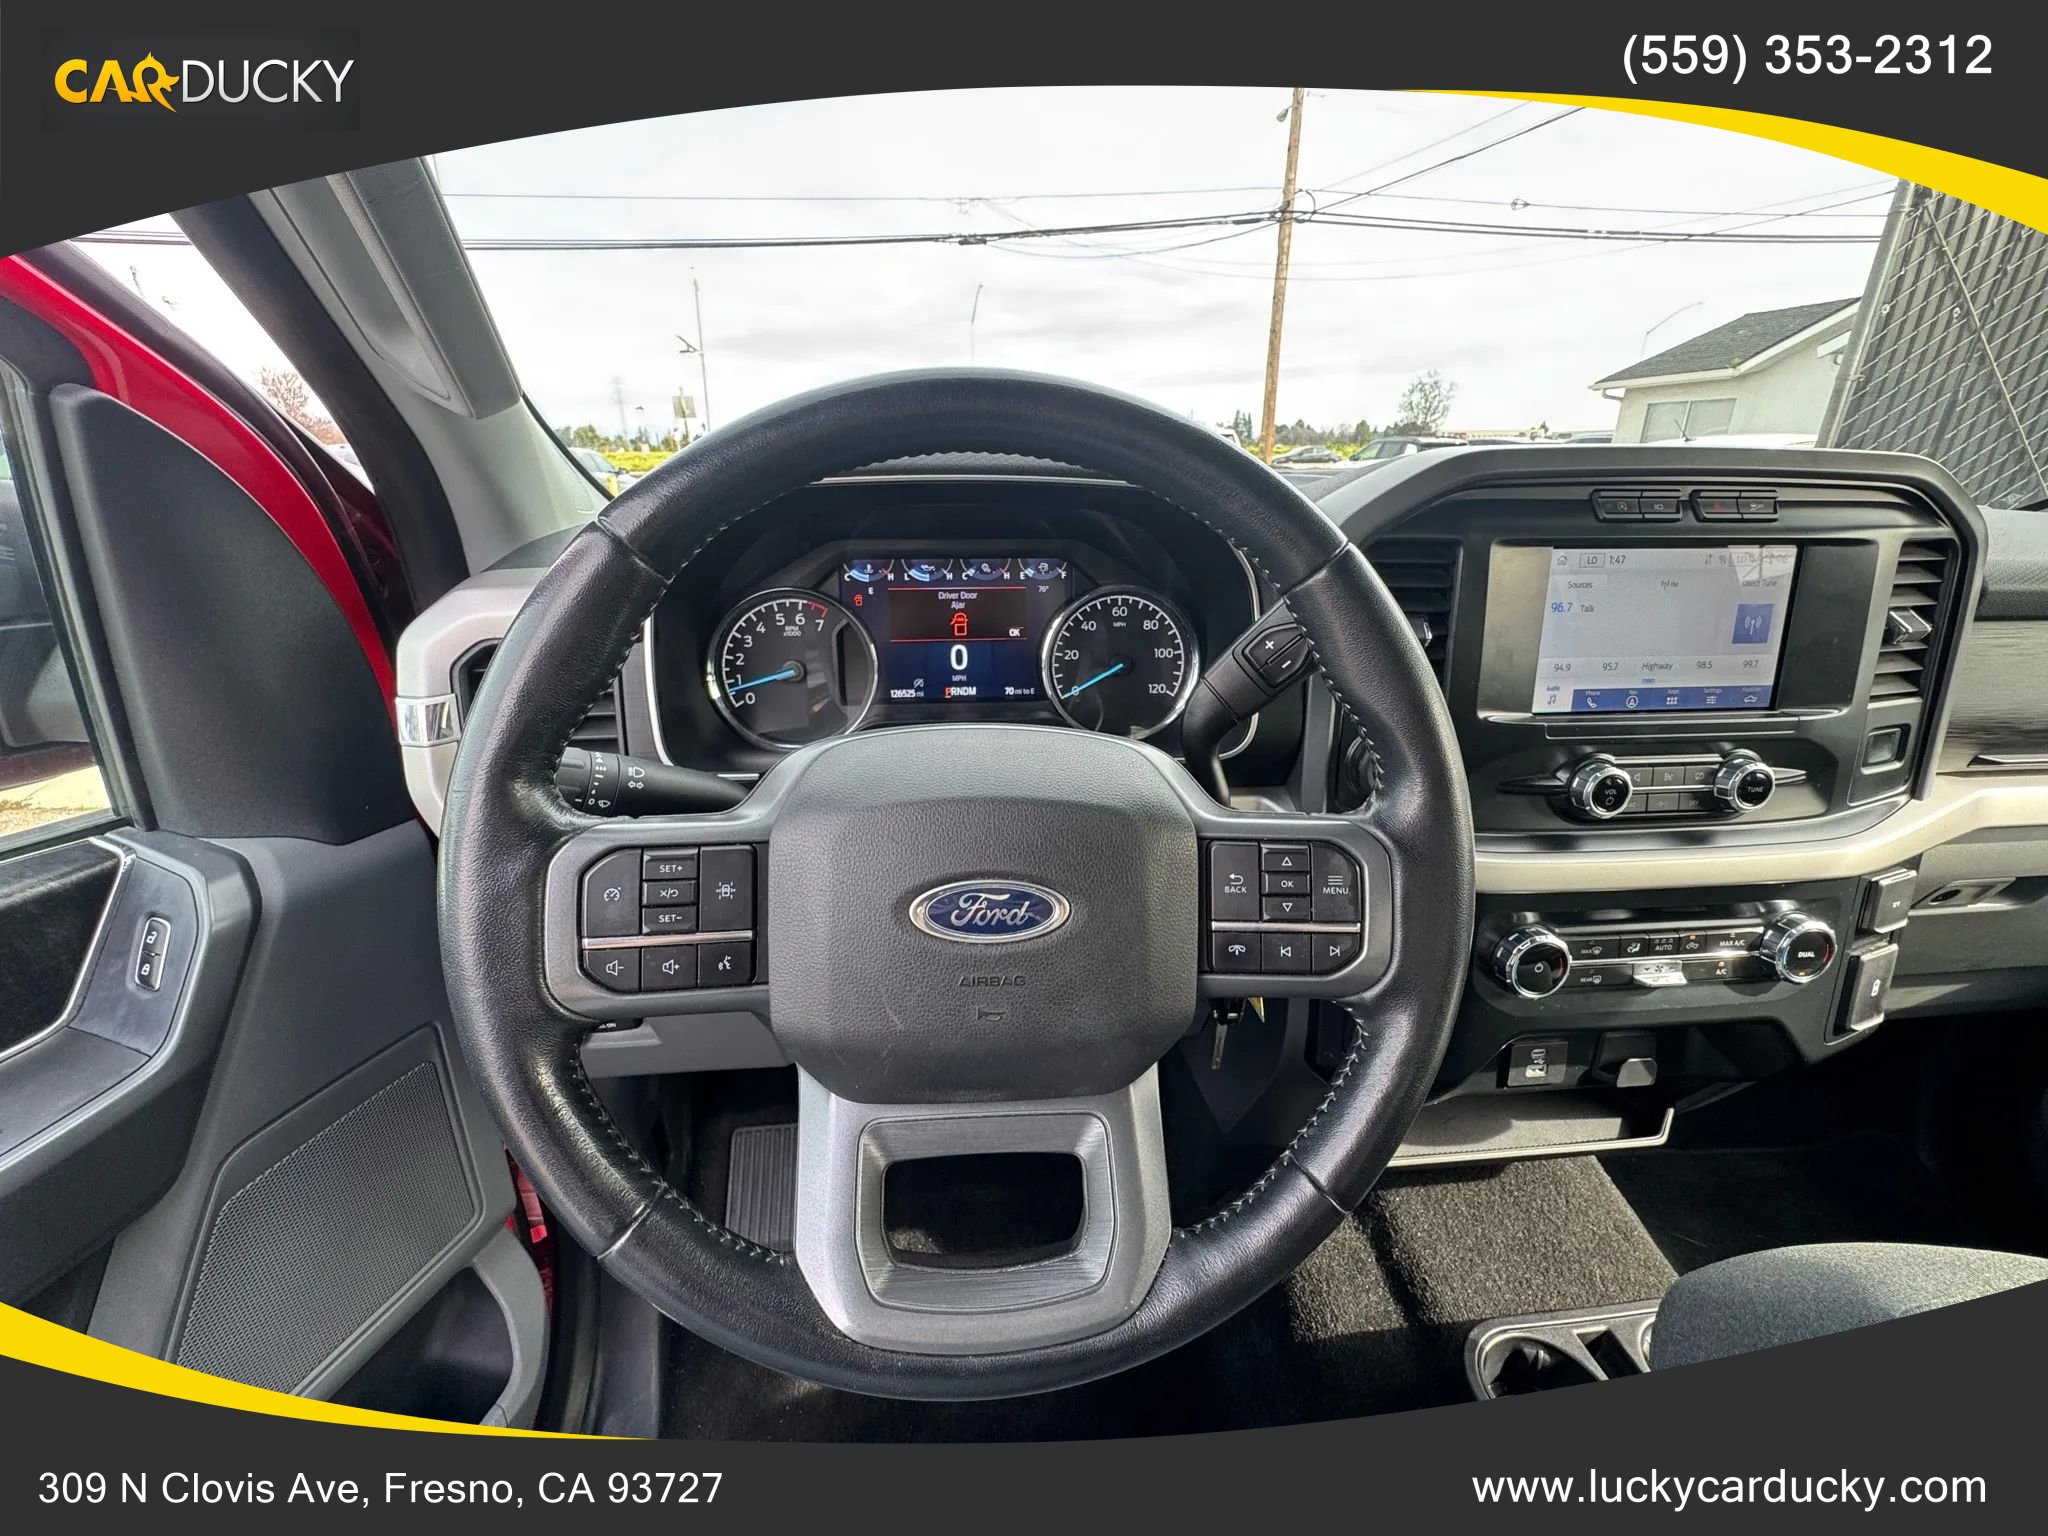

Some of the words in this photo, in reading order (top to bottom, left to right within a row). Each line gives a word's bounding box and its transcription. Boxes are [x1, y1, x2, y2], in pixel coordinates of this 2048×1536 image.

[1608, 555, 1626, 565] 1:47
[844, 573, 850, 581] C
[888, 573, 894, 581] H
[904, 573, 910, 581] L
[962, 572, 968, 580] C
[1004, 572, 1010, 580] H
[1020, 572, 1026, 580] E
[1568, 580, 1593, 589] Sources
[868, 587, 874, 595] E
[938, 591, 959, 599] Driver
[960, 591, 978, 599] Door
[951, 601, 965, 609] Ajar
[1551, 602, 1573, 613] 96.7
[1580, 604, 1595, 613] Talk
[1112, 607, 1127, 617] 60
[776, 613, 785, 626] 5
[795, 613, 805, 625] 6
[756, 622, 766, 634] 4
[815, 619, 825, 632] 7
[1081, 621, 1097, 631] 40
[1143, 620, 1159, 630] 80
[1008, 628, 1020, 637] OK
[743, 635, 753, 648] 3
[950, 644, 968, 671] 0
[1064, 650, 1079, 660] 20
[1154, 648, 1174, 659] 100
[735, 653, 745, 666] 2
[1553, 663, 1572, 672] 94.9
[1602, 662, 1620, 671] 95.7
[1696, 660, 1713, 670] 98.5
[1743, 659, 1759, 669] 99.7
[735, 674, 742, 686] 1
[1004, 687, 1015, 696] 70
[1148, 683, 1167, 694] 120
[890, 689, 916, 698] 126525
[745, 692, 756, 705] 0
[1604, 788, 1617, 796] VOL
[659, 864, 683, 873] SET+
[1280, 880, 1294, 888] OK
[1224, 886, 1247, 894] BACK
[1322, 886, 1349, 895] MENU
[951, 892, 1043, 927] Ford
[658, 914, 683, 923] SET-
[1733, 939, 1746, 947] A/C
[1797, 951, 1815, 959] DUAL
[1715, 968, 1727, 976] A/C
[958, 975, 1027, 988] AIRBAG
